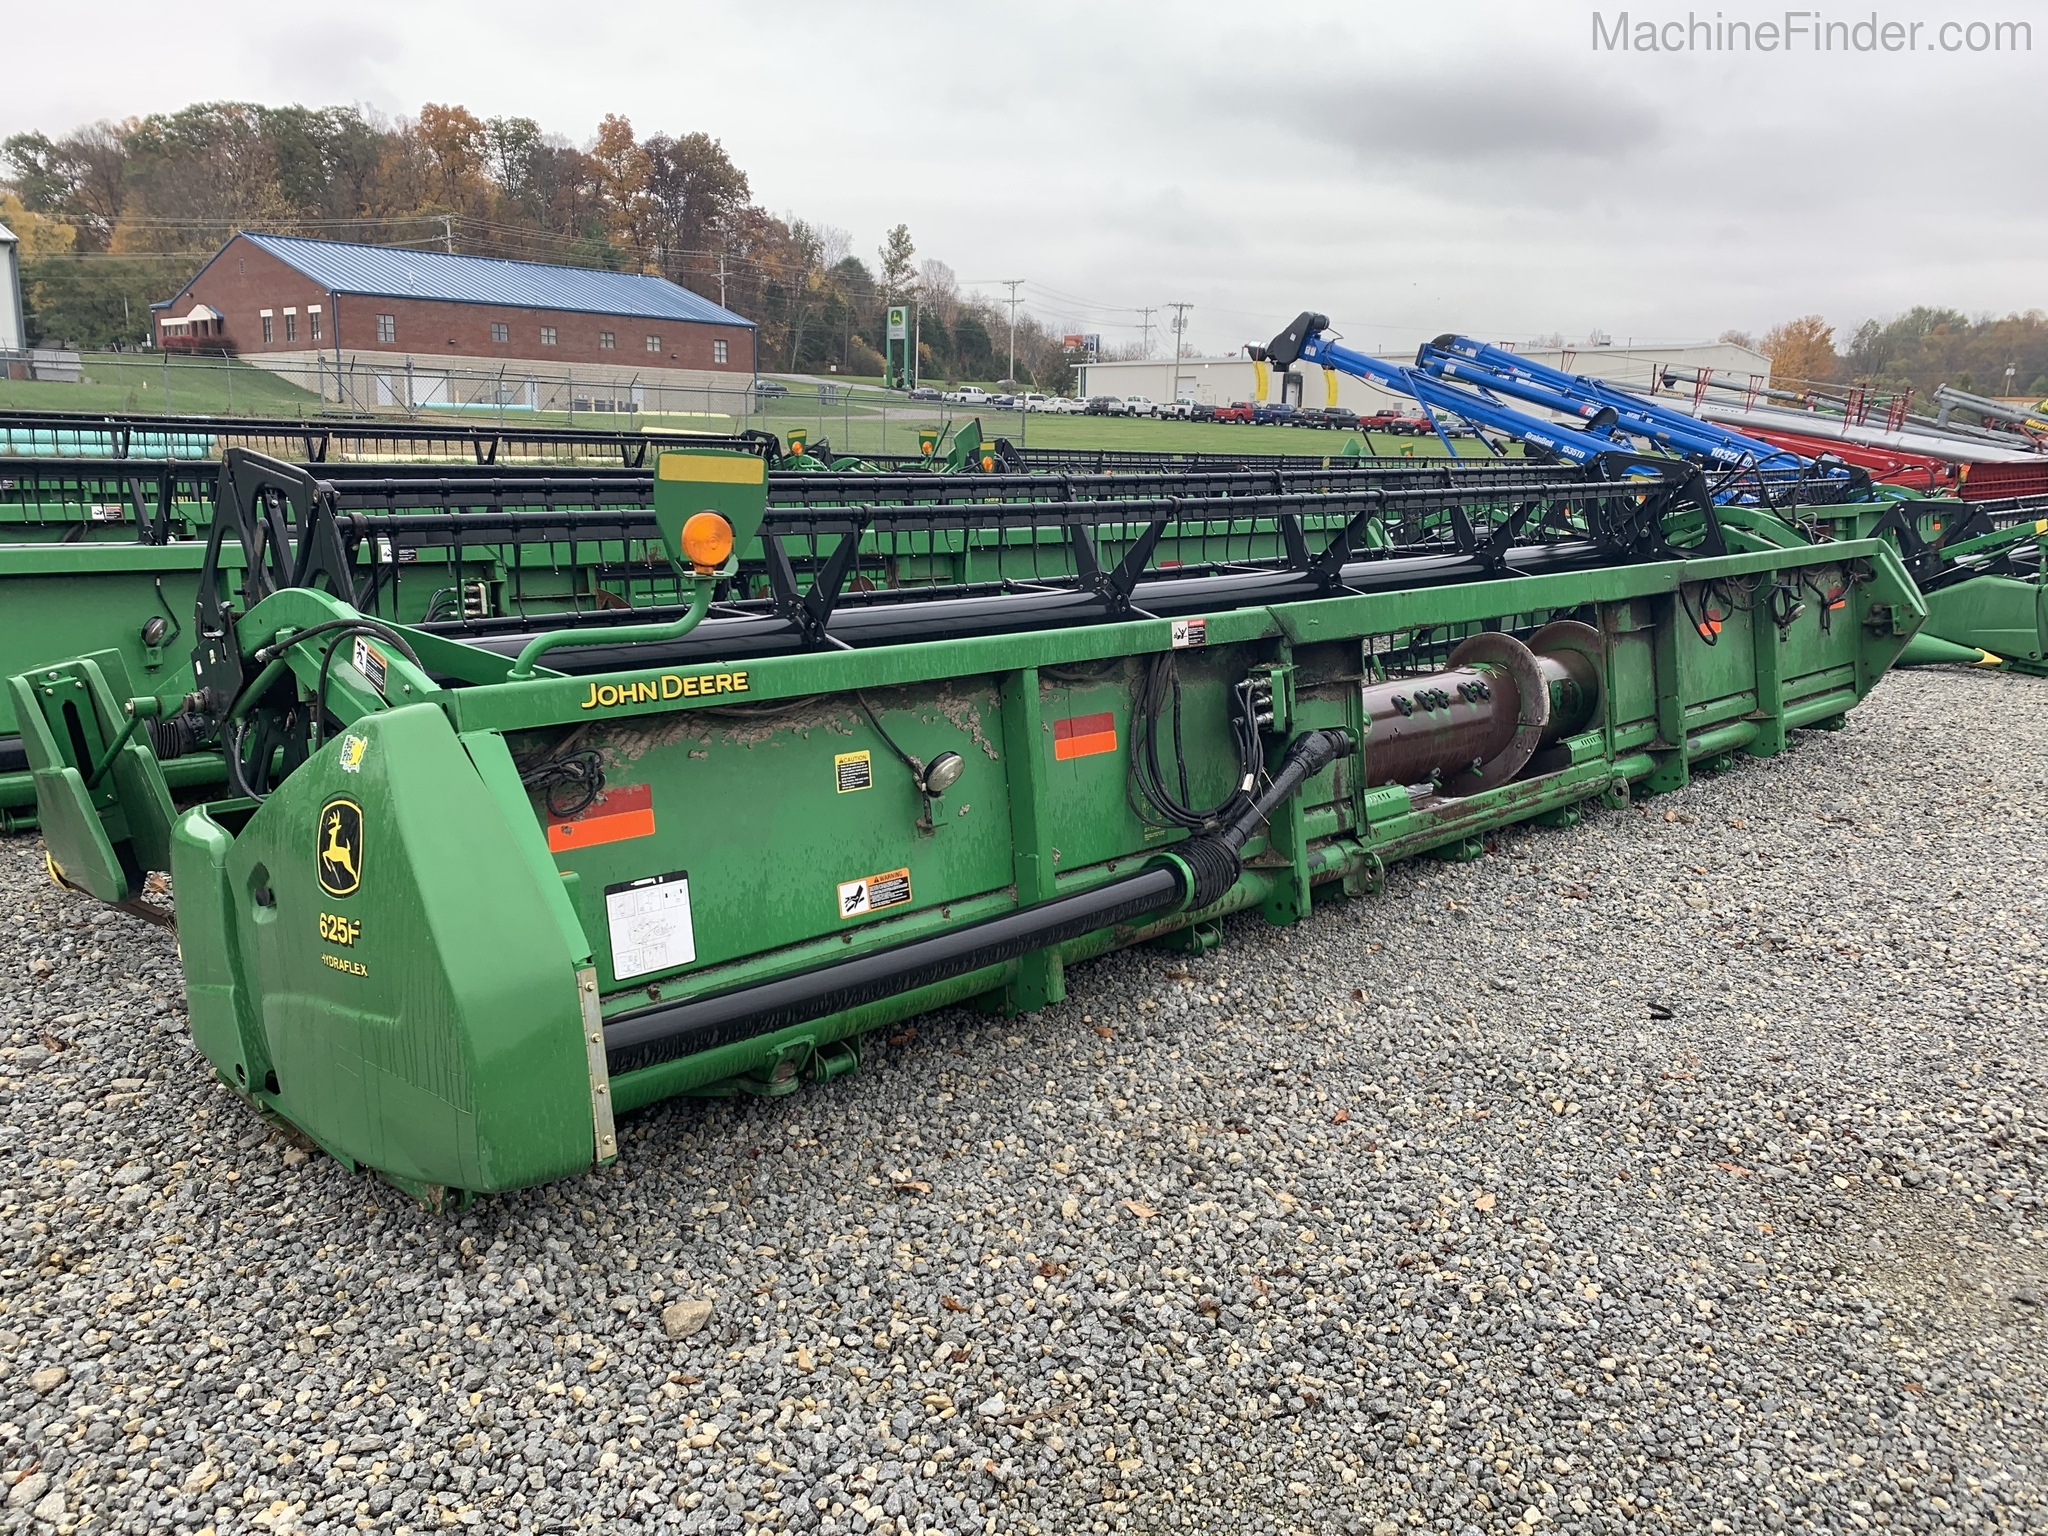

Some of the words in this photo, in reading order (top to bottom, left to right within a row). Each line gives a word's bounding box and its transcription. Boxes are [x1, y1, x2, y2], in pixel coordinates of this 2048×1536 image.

[1525, 431, 1555, 448] GrainBelt
[581, 682, 659, 709] JOHN
[660, 671, 749, 699] DEERE
[843, 754, 867, 763] CAUTION
[879, 871, 903, 882] WARNING
[319, 911, 361, 947] 625F
